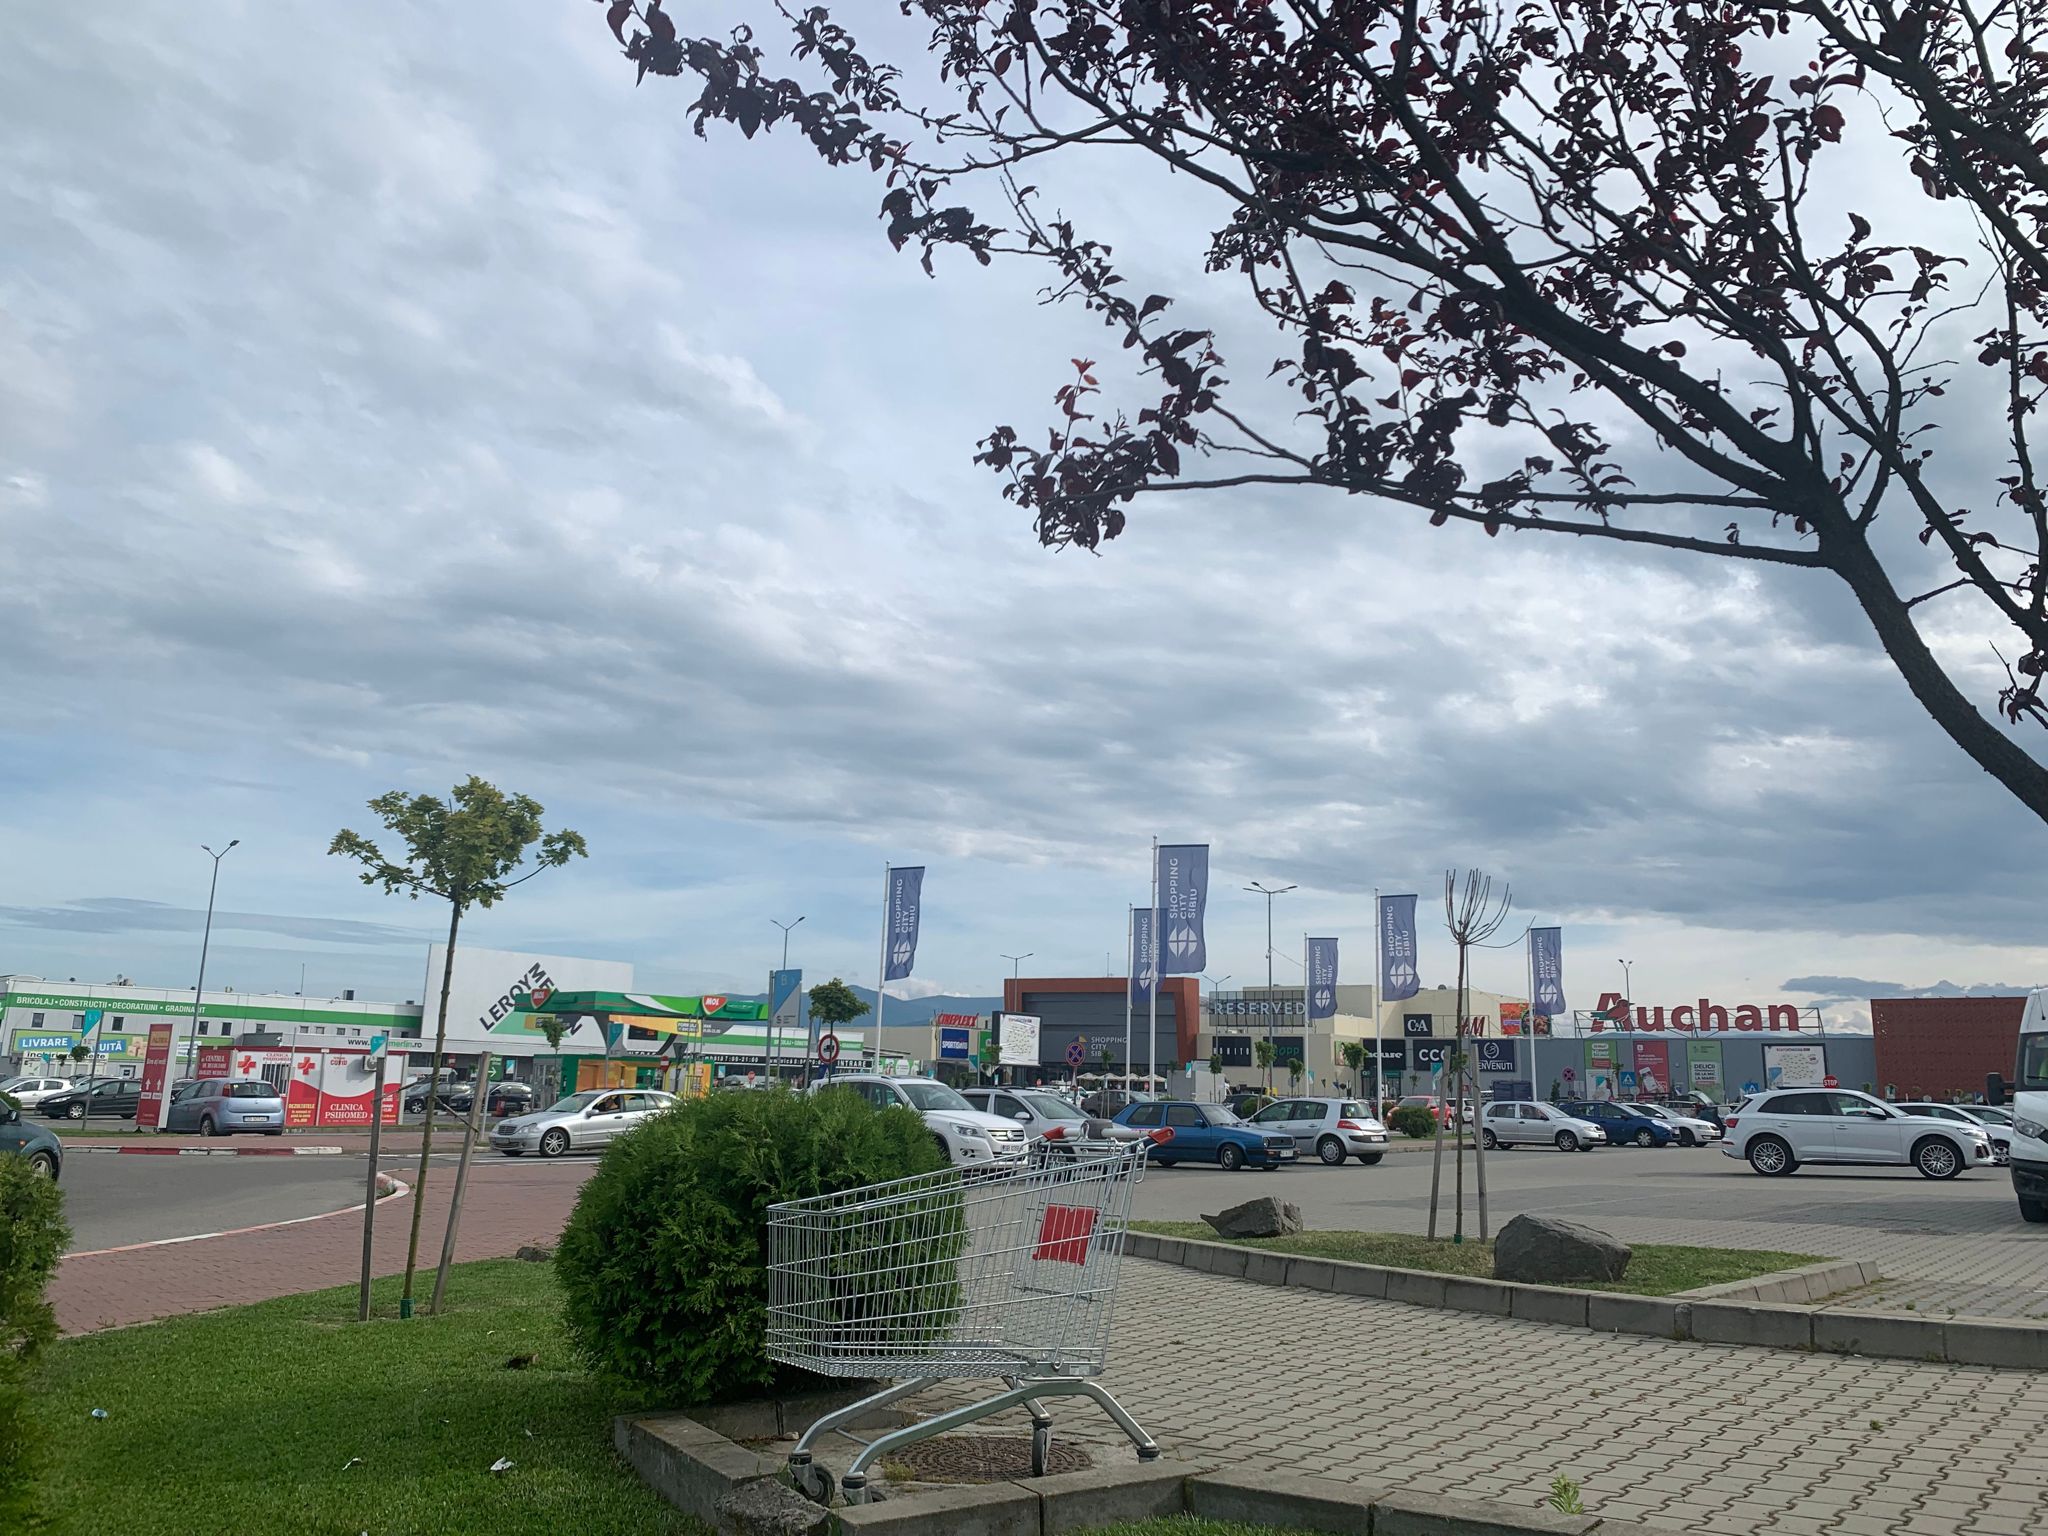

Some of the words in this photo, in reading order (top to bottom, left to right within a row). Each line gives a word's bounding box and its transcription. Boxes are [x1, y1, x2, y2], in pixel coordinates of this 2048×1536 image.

[1169, 857, 1179, 919] SHOPPING
[895, 879, 903, 934] SHOPPING
[1180, 892, 1188, 920] CITY
[1188, 888, 1198, 919] SIBIU
[901, 910, 909, 934] CITY
[908, 905, 916, 932] SIBIU
[1387, 905, 1395, 957] SHOPPING
[1140, 917, 1148, 963] SHOPPING
[1395, 934, 1403, 957] CITY
[1537, 936, 1545, 979] SHOPPING
[16, 996, 54, 1006] BRICOLAJ
[59, 999, 107, 1009] CONSTRUCTII
[112, 1002, 158, 1011] DECORATIUNI
[165, 1005, 206, 1014] GRADINAIT
[479, 974, 532, 1031] LEROY
[705, 997, 719, 1006] MOL
[1214, 1002, 1306, 1015] RESERVED
[1591, 993, 1799, 1033] Auchan
[1407, 1019, 1428, 1032] C&A
[22, 1037, 68, 1048] LIVRARE
[1091, 1036, 1128, 1044] SHOPPING
[1478, 1061, 1513, 1071] ENVENUTI
[325, 1111, 368, 1119] PSIHOMED
